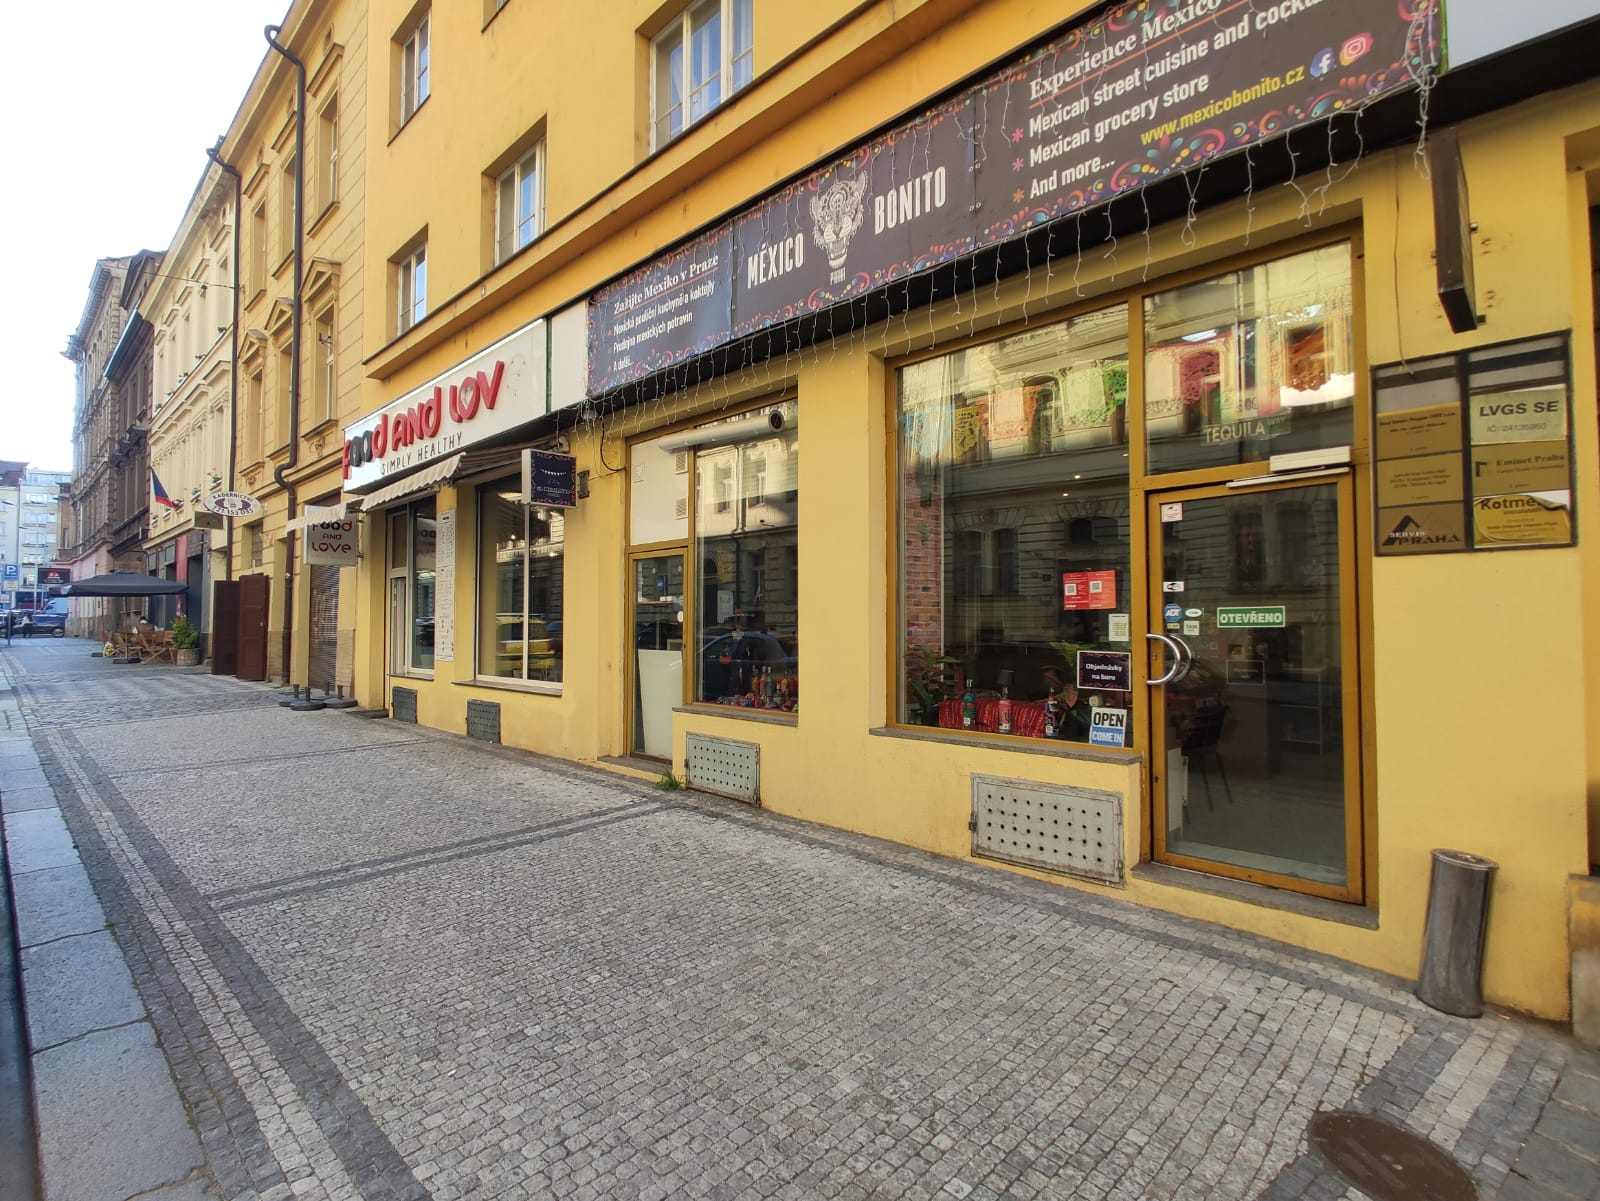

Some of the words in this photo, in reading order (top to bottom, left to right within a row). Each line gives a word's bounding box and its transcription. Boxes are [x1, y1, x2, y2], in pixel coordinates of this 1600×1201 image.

[1029, 33, 1137, 101] Experience
[1141, 0, 1221, 44] Mexico
[1029, 97, 1090, 138] Mexican
[1094, 69, 1141, 106] street
[1146, 40, 1209, 82] cuisine
[1214, 13, 1249, 51] and
[1256, 0, 1321, 30] cock
[1141, 65, 1305, 146] www.mexicobonito.cz
[1029, 127, 1090, 168] Mexican
[1095, 96, 1158, 143] grocery
[1164, 74, 1209, 107] store
[1030, 174, 1058, 200] And
[1062, 156, 1116, 185] more...
[747, 232, 804, 289] MÉXICO
[874, 166, 946, 235] BONITO
[644, 274, 679, 300] Mexiko
[680, 270, 688, 281] v
[689, 255, 719, 278] Praze
[684, 295, 689, 304] a
[667, 311, 693, 333] potravin
[1479, 403, 1527, 417] LVGS
[1533, 401, 1559, 413] SE
[1205, 421, 1266, 443] TEQUILA
[1267, 416, 1287, 425] WAY
[381, 451, 412, 476] SIMPLY
[417, 432, 463, 461] HEALTHY
[1480, 498, 1541, 511] Kotme
[1389, 530, 1425, 538] SERVIS
[1398, 534, 1461, 545] PRAHA
[1220, 610, 1283, 624] OTEVŘENO
[1093, 711, 1125, 727] OPEN
[1091, 731, 1113, 742] COME
[1113, 732, 1122, 743] IN
